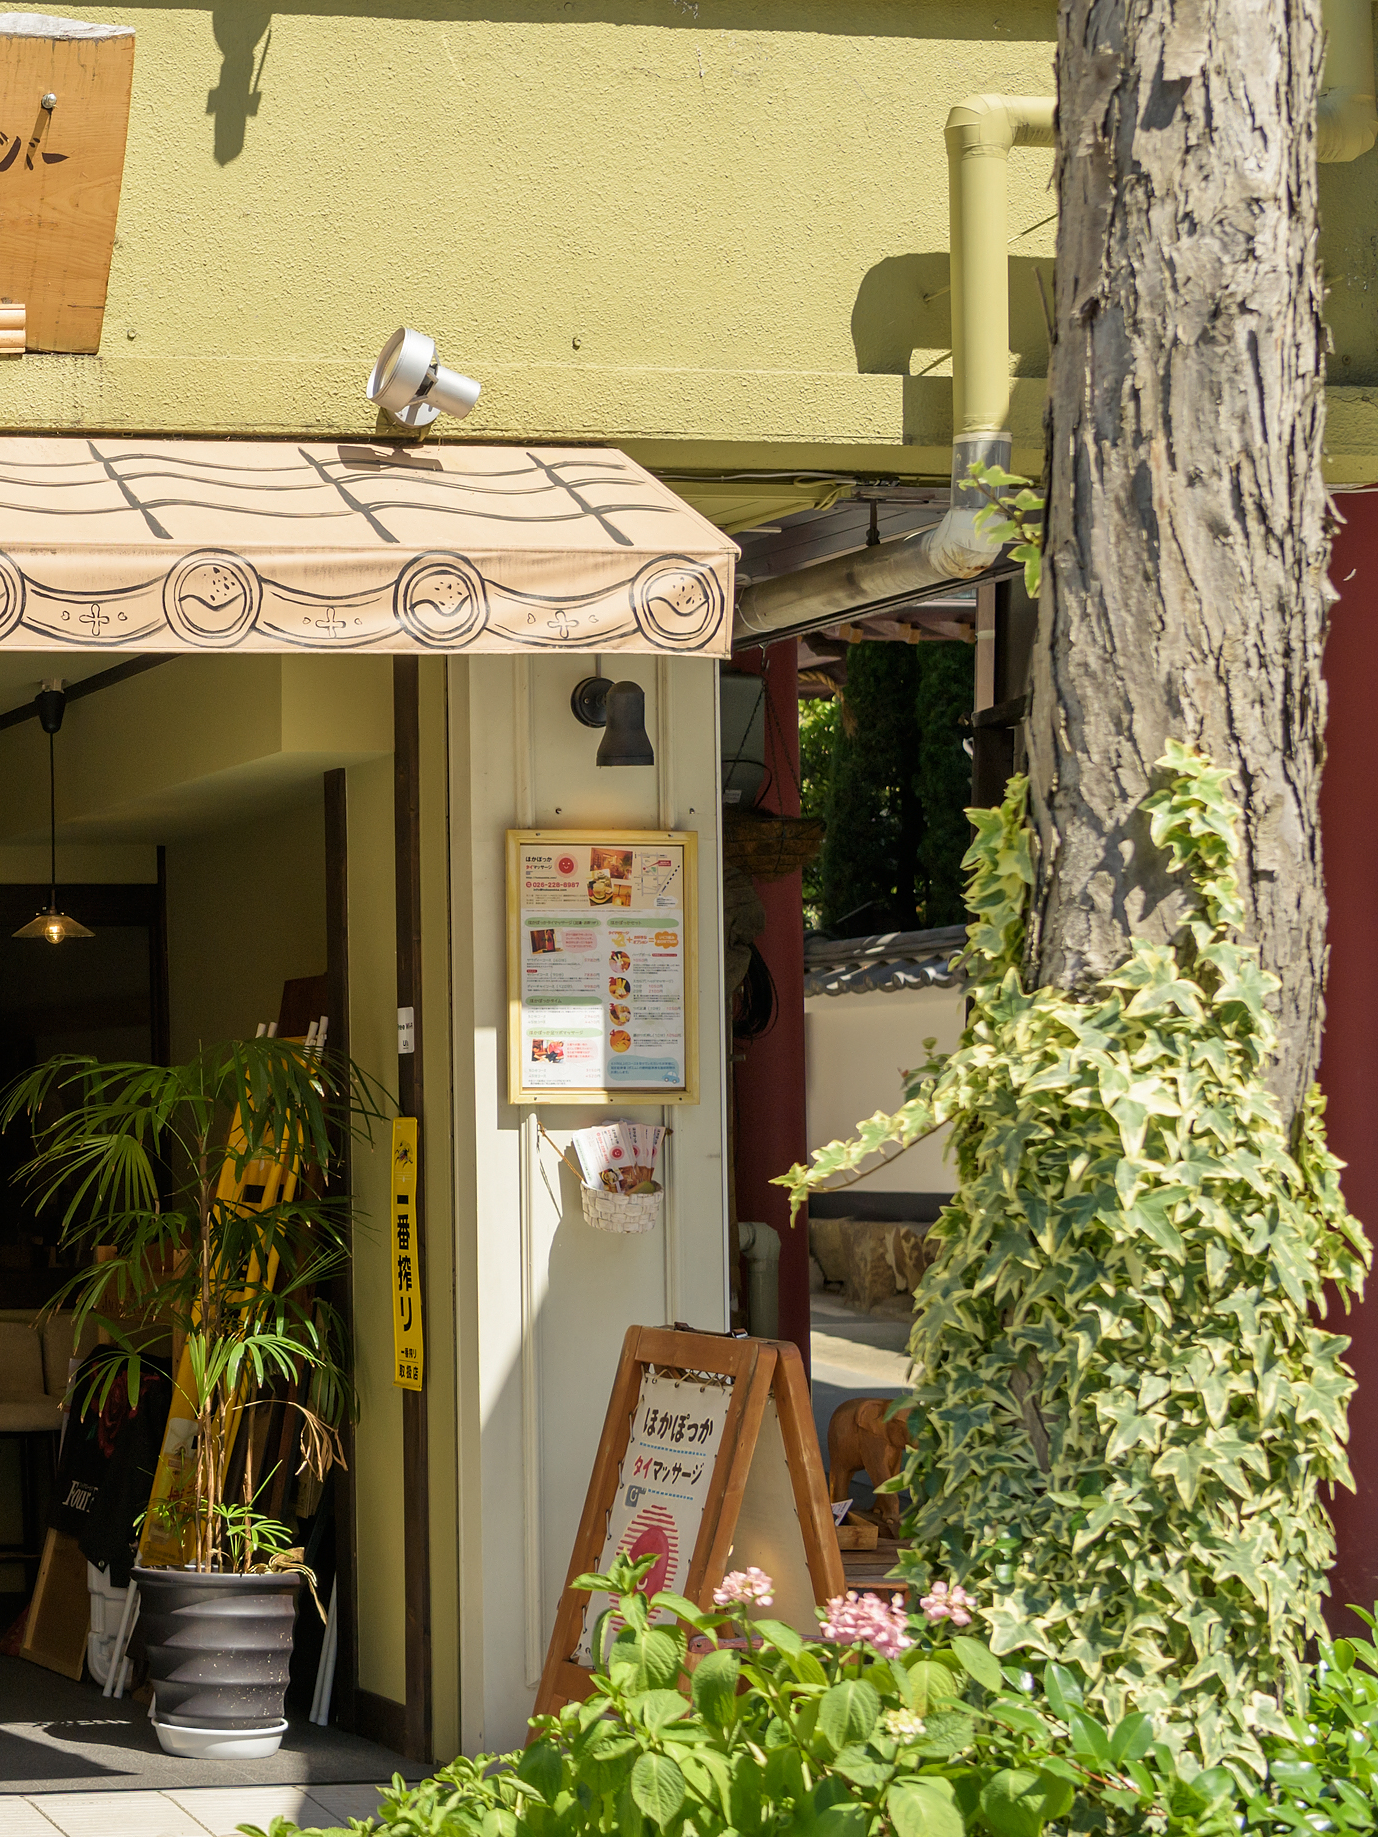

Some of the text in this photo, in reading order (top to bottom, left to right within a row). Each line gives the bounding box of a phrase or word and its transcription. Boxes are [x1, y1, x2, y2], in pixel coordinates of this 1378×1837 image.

[397, 1194, 413, 1332] 一番搾り
[643, 1407, 713, 1444] ほかぽっか
[633, 1455, 704, 1485] タイマッサージ
